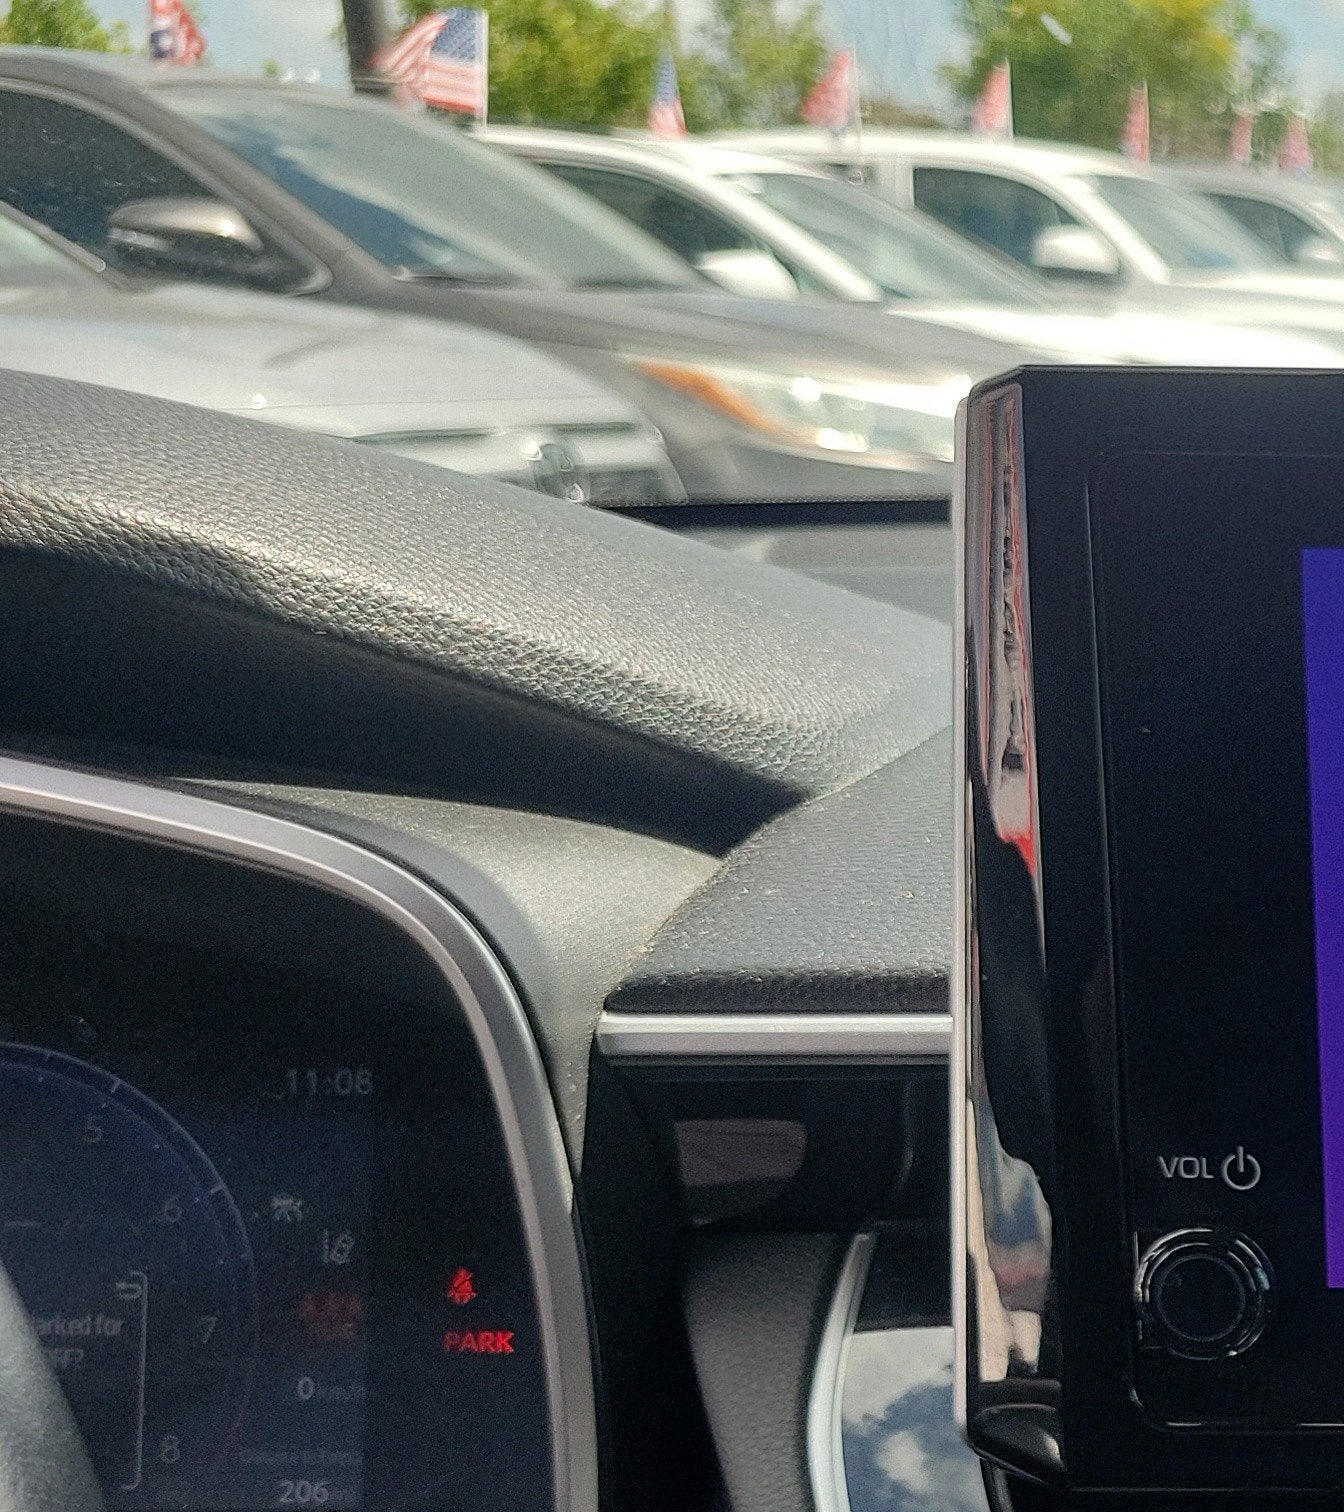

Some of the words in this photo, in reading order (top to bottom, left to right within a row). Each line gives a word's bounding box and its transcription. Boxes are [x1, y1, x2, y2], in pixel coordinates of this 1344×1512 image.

[286, 1067, 374, 1096] 11:08
[1157, 1155, 1215, 1179] VOL
[200, 1315, 219, 1345] 7
[443, 1330, 515, 1353] PARK
[160, 1434, 181, 1464] 8
[278, 1479, 330, 1504] 206
